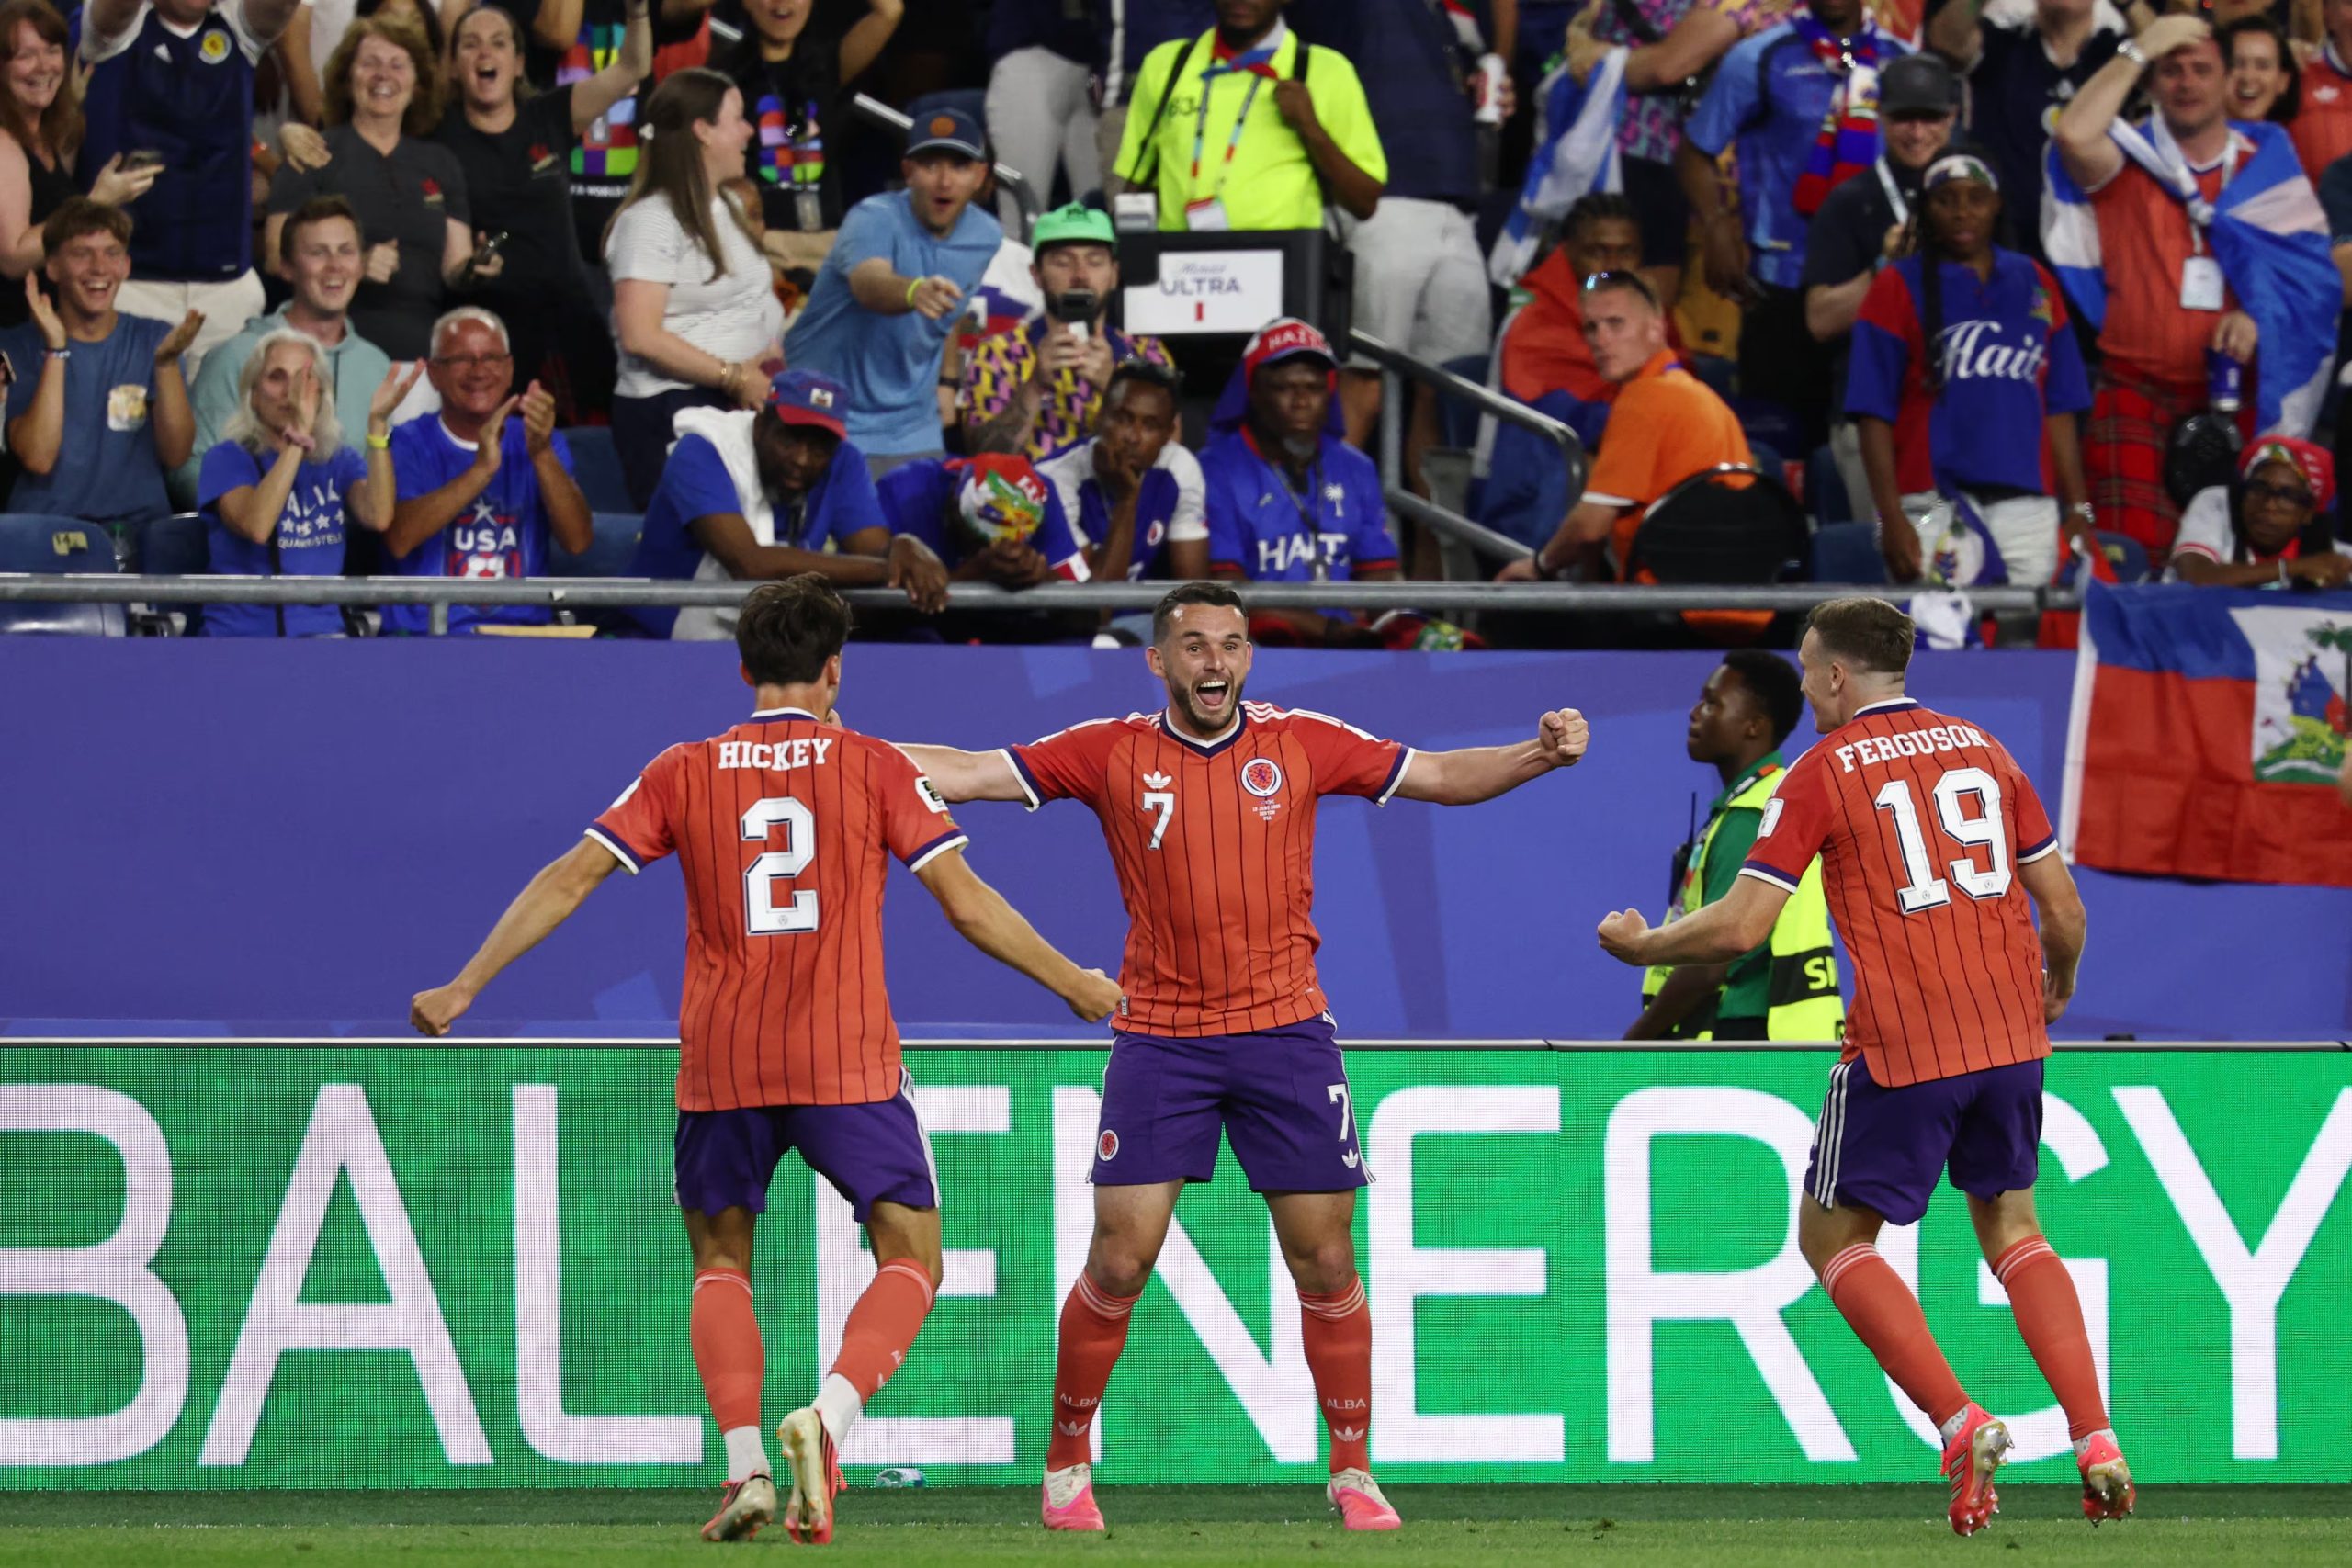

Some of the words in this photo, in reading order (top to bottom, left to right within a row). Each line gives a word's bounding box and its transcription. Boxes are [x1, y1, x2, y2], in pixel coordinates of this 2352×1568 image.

[1159, 277, 1242, 296] ULTRA
[455, 525, 517, 552] USA
[1258, 532, 1350, 572] HAIT
[718, 738, 833, 771] HICKEY
[1835, 725, 1992, 773] FERGUSON
[1142, 792, 1175, 851] 7
[1874, 767, 2012, 915] 19
[741, 796, 820, 937] 2
[1327, 1083, 1350, 1142] 7
[815, 1083, 2352, 1466] ENERGY
[1060, 1393, 1098, 1407] ALBA
[1327, 1397, 1366, 1410] ALBA
